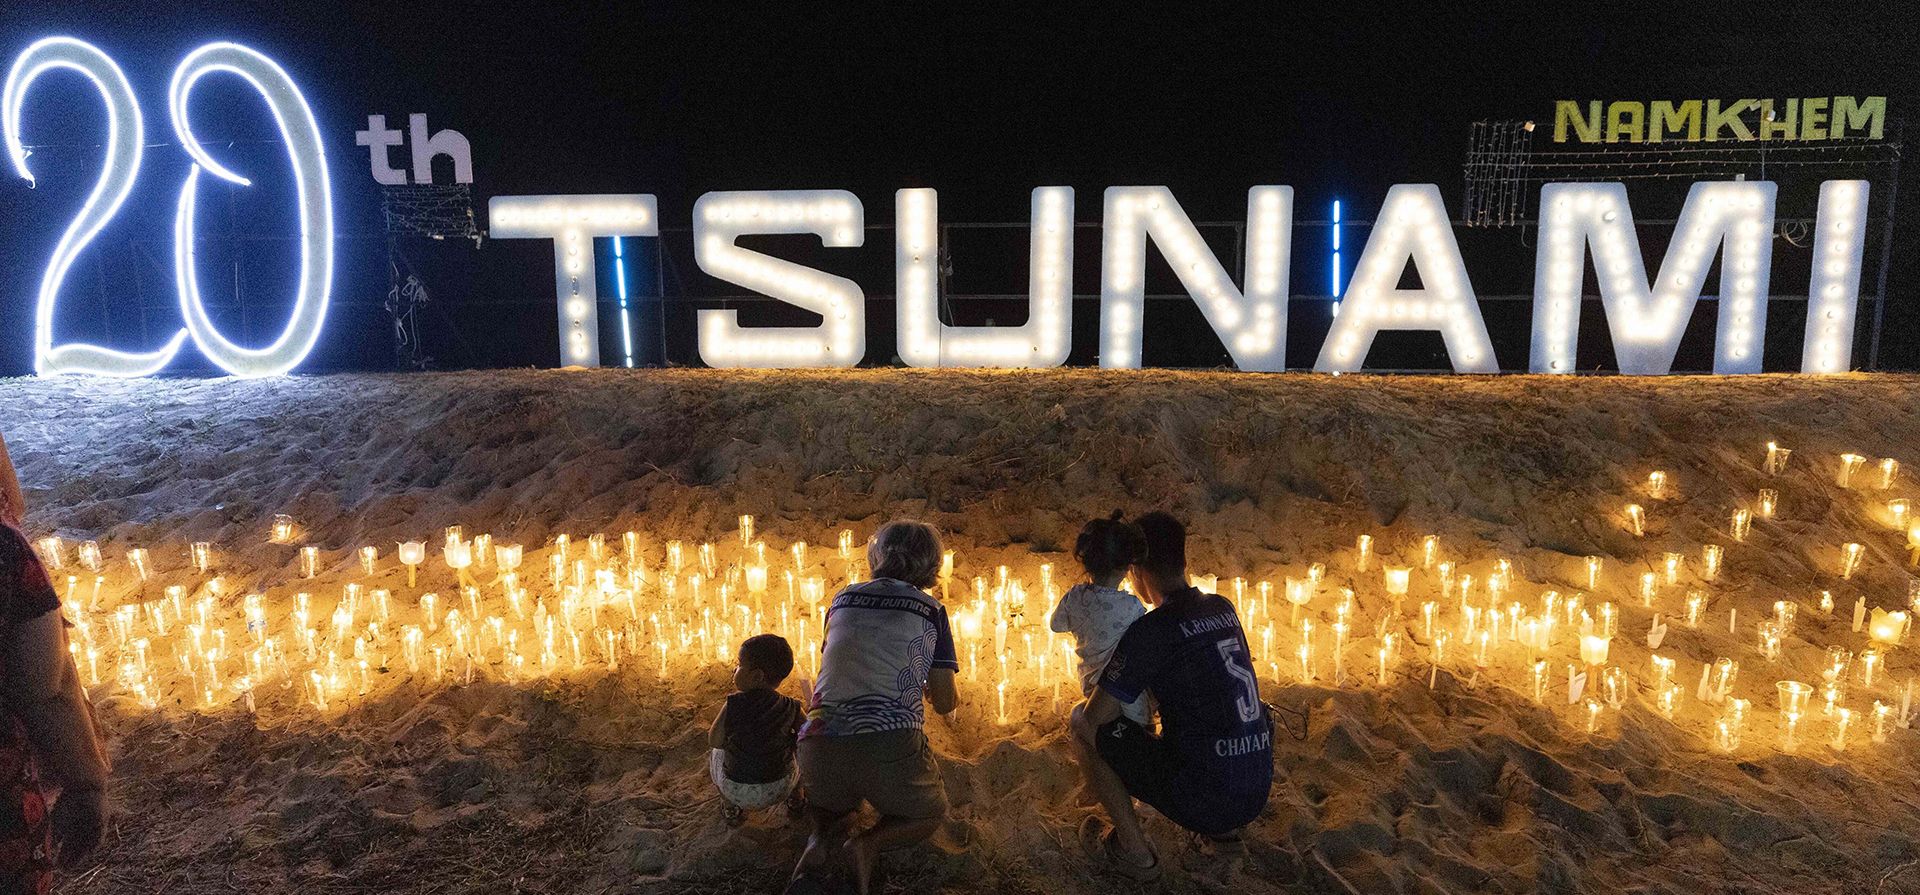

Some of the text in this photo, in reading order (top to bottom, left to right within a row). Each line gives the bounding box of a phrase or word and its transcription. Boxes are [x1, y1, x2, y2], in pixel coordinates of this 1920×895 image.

[1553, 96, 1887, 143] NAMKHEM
[488, 180, 1870, 374] TSUNAMI
[881, 597, 931, 616] RUNNING
[1216, 638, 1260, 722] 5
